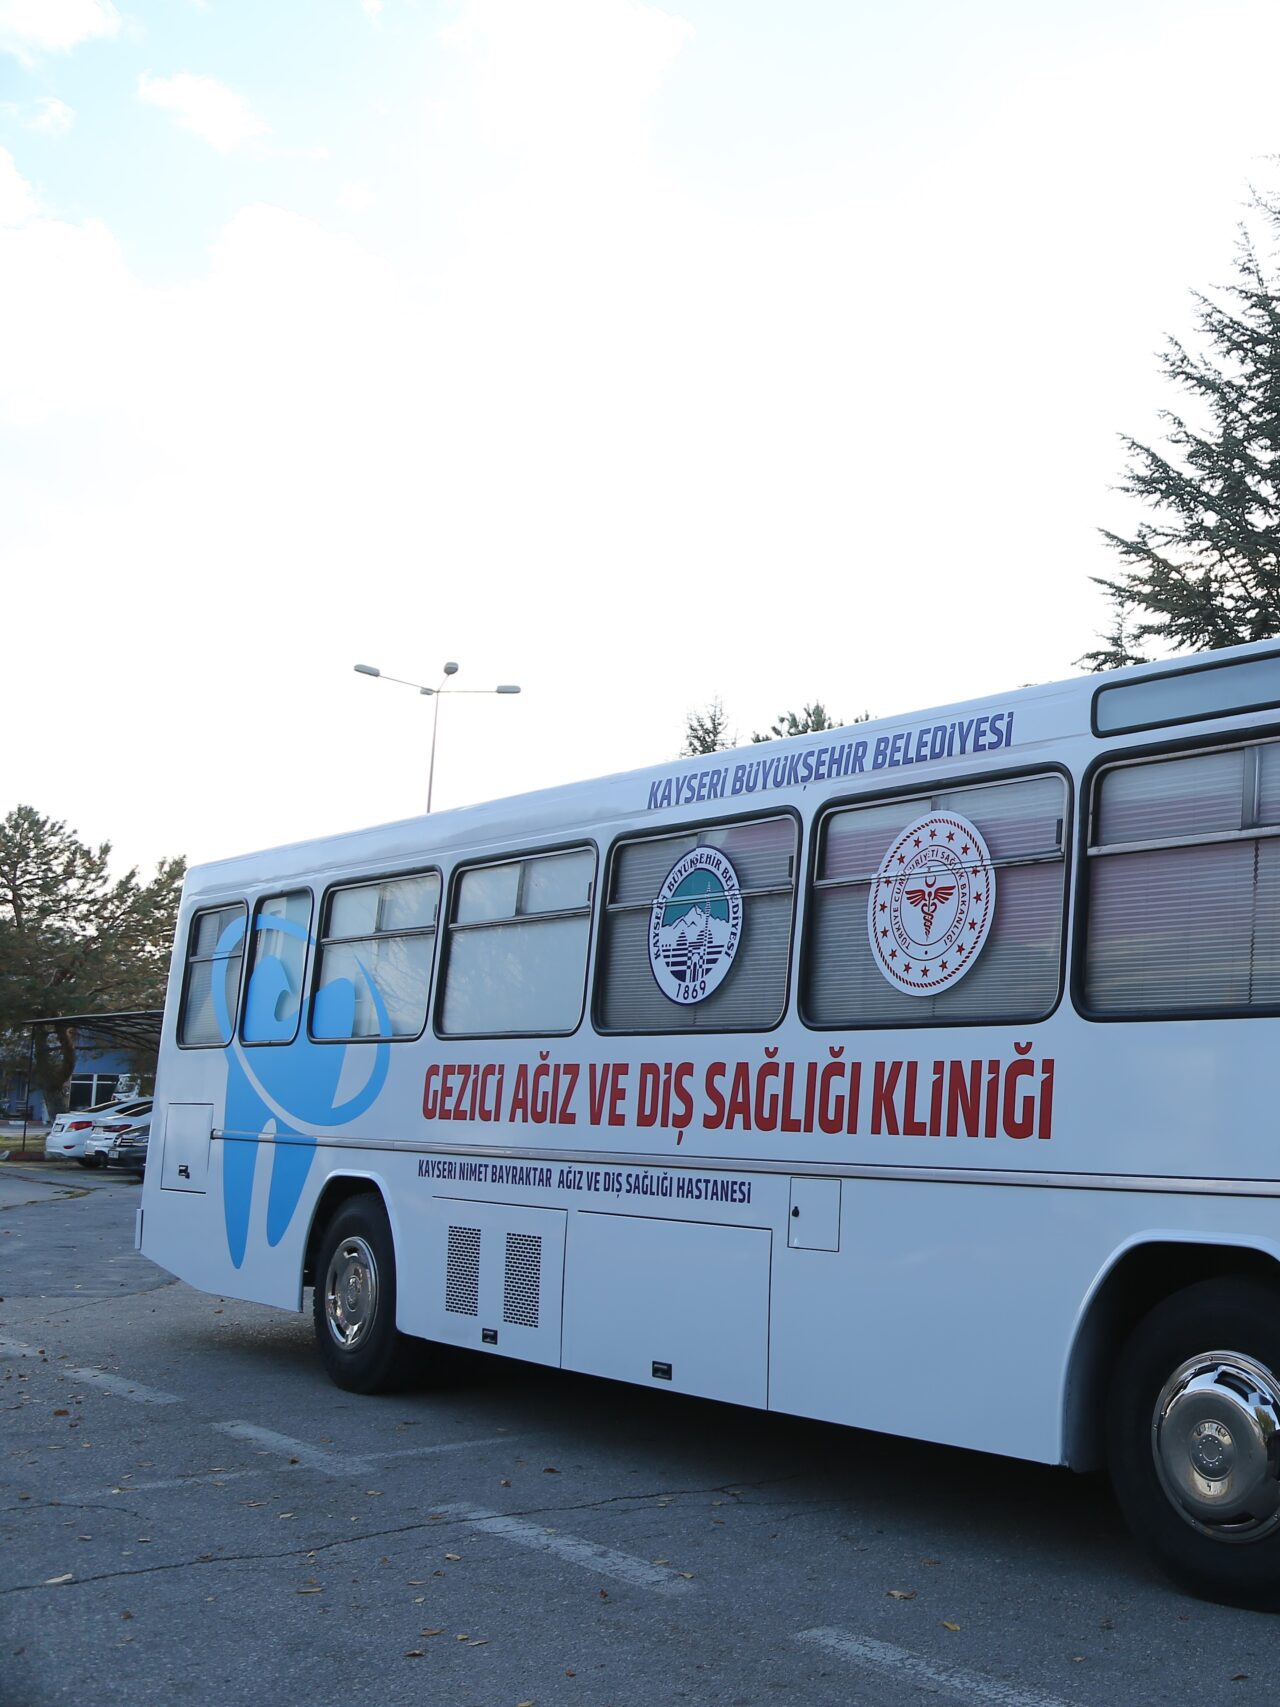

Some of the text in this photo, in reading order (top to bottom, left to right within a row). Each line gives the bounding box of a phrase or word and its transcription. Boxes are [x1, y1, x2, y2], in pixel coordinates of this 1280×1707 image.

[647, 711, 1014, 809] KAYSERİ BÜYÜKŞEHİR BELEDİYESİ
[676, 980, 706, 1000] 1869
[422, 1042, 1055, 1146] GEZİCİ AĞIZ VE DİŞ SAĞLIĞI KLİNİĞİ
[418, 1159, 752, 1204] KAYSERİ NİMET BAYRAKTAR AĞIZ VE DİŞ SAĞLIĞI HASTANESİ
